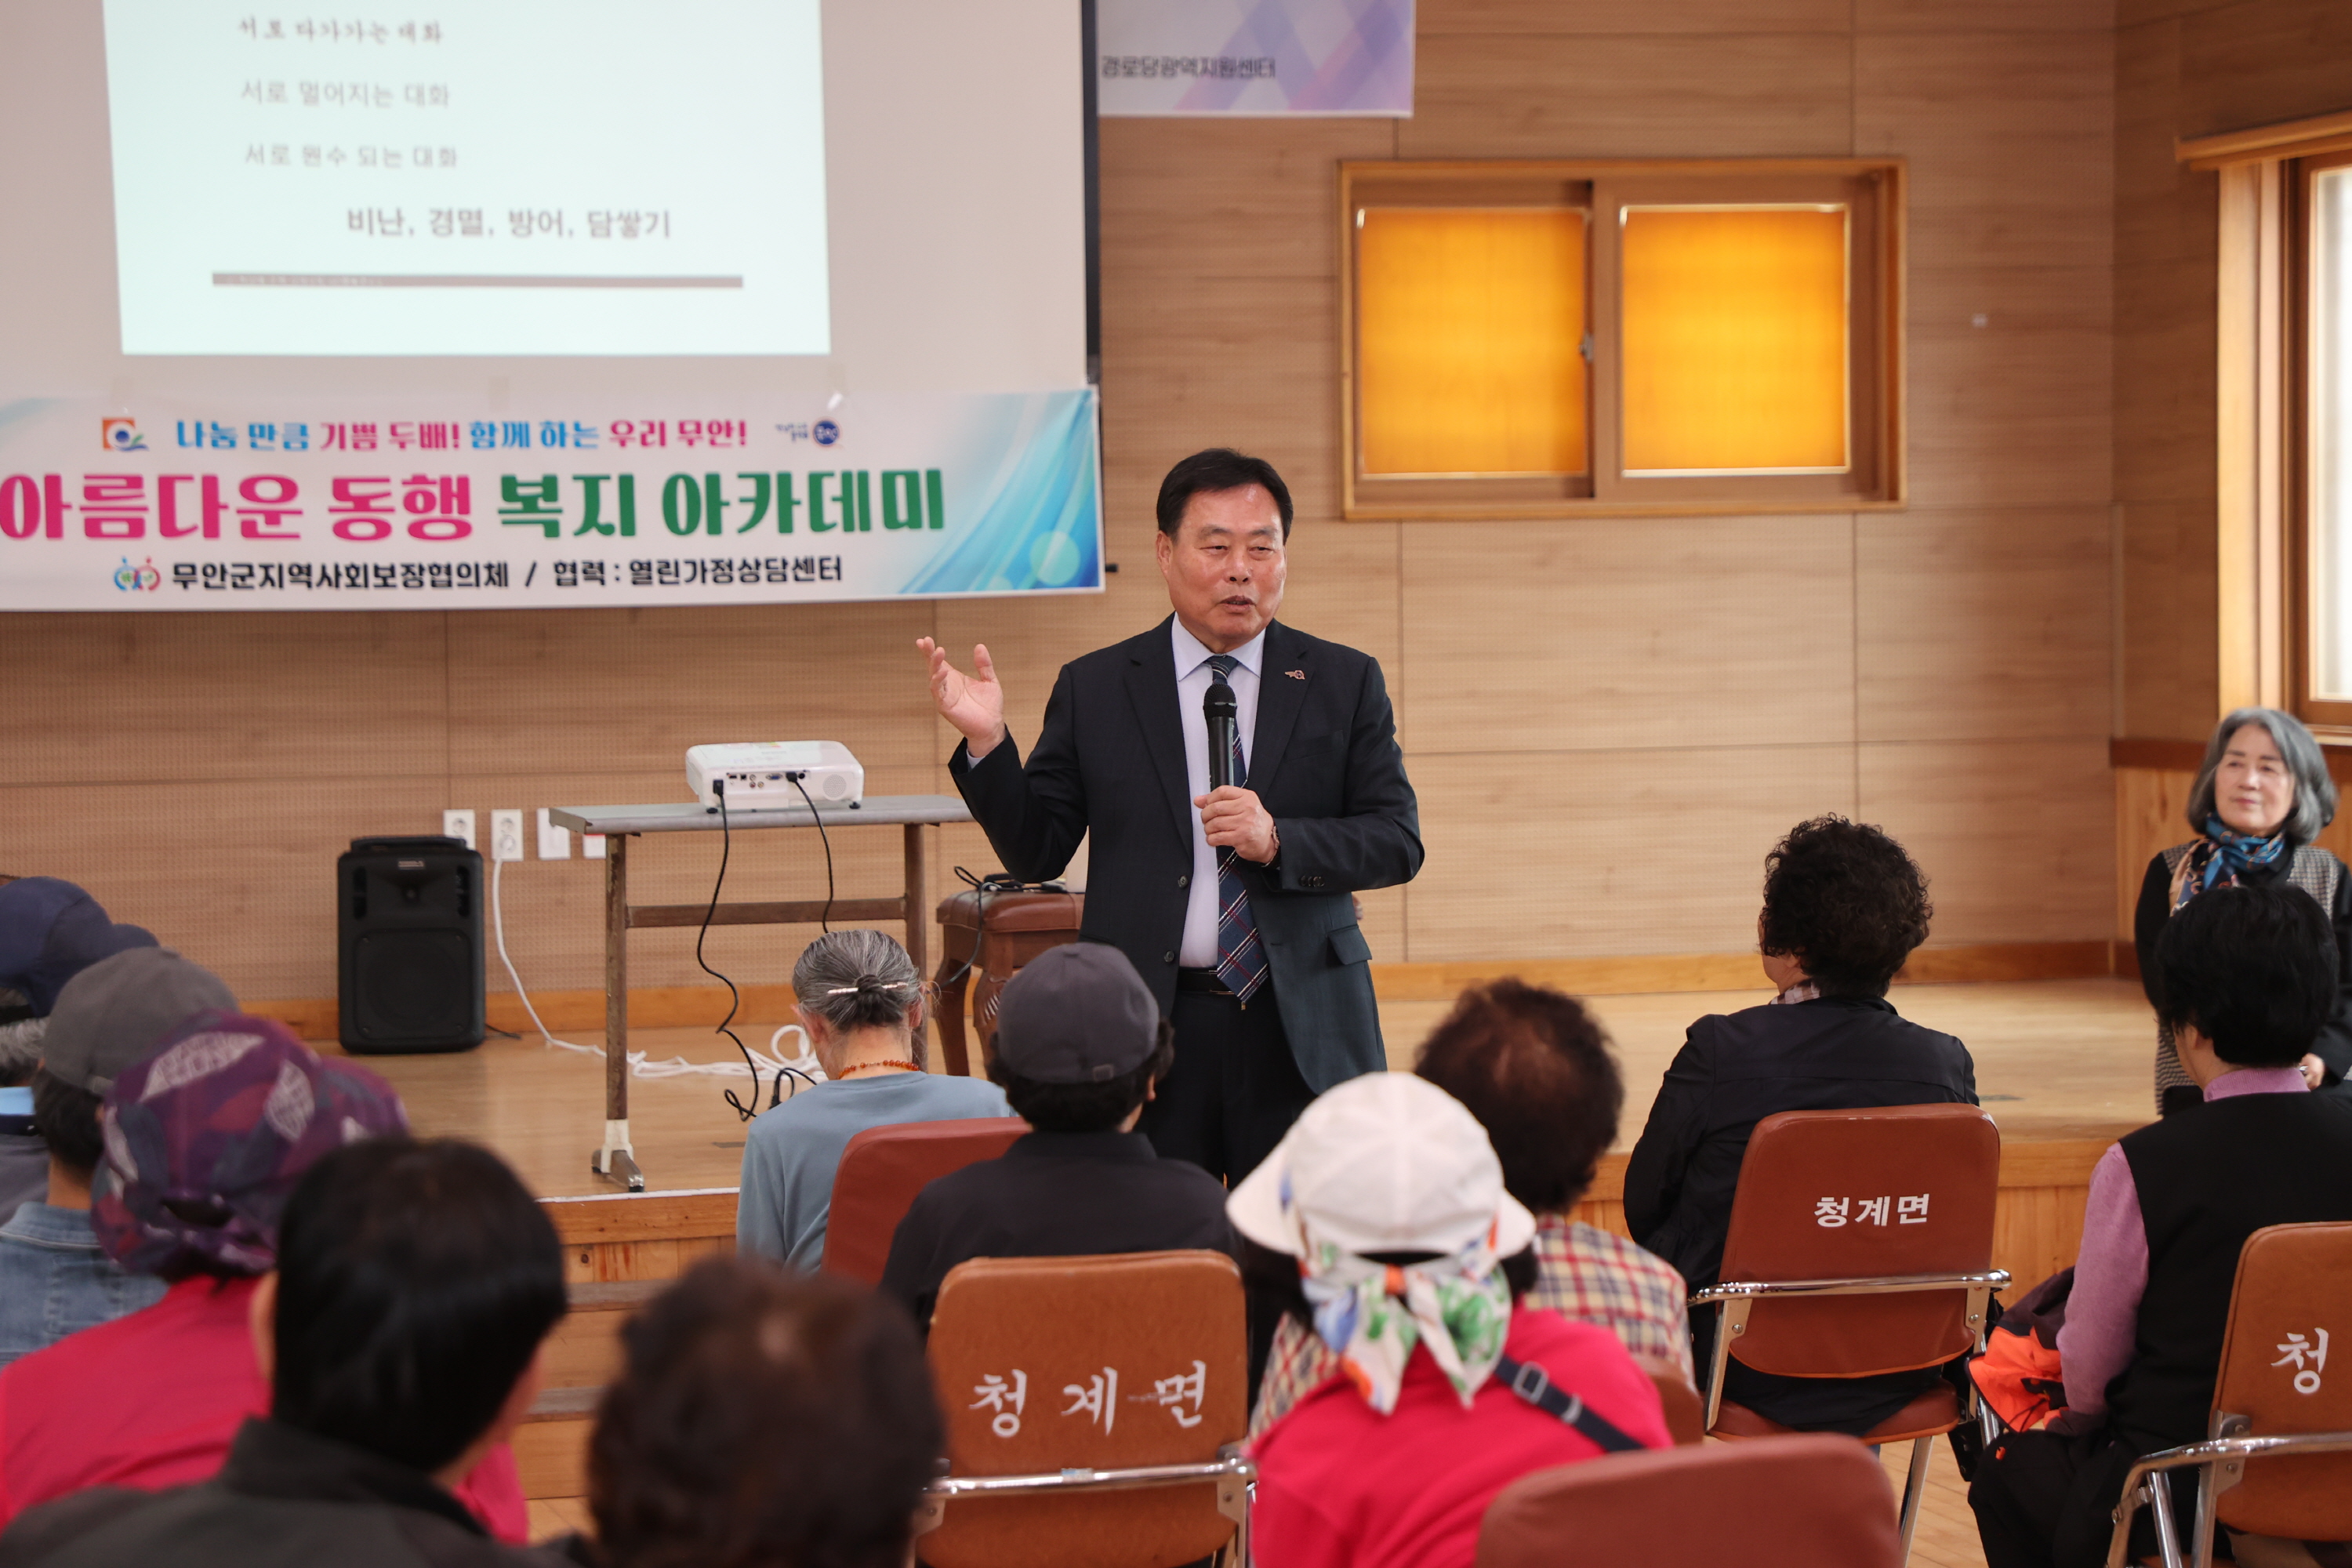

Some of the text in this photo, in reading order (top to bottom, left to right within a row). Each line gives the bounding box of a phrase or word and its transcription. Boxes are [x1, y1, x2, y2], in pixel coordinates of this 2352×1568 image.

[239, 14, 285, 40] 서로
[241, 78, 449, 107] 서로 멀어지는 대화
[245, 143, 290, 165] 서로
[358, 145, 402, 169] 되는
[412, 145, 458, 168] 대화
[347, 208, 415, 237] 비난,
[429, 208, 495, 238] 경멸,
[508, 209, 574, 238] 방어,
[177, 420, 237, 449] 나눔
[248, 422, 309, 451] 만큼
[320, 421, 377, 451] 기쁨
[389, 421, 460, 451] 두배!
[470, 420, 531, 449] 함께
[539, 420, 599, 449] 하는
[609, 419, 667, 448] 우리
[677, 419, 746, 448] 무안!
[0, 469, 945, 541] 아름다운 동행 복지 아카데미
[172, 561, 509, 591] 무안군지역사회보장협의체
[524, 561, 537, 587] /
[554, 559, 607, 586] 협력
[629, 555, 842, 586] 열린가정상담센터
[1814, 1193, 1930, 1228] 청계면
[2270, 1327, 2329, 1395] 청
[969, 1359, 1207, 1438] 청계면
